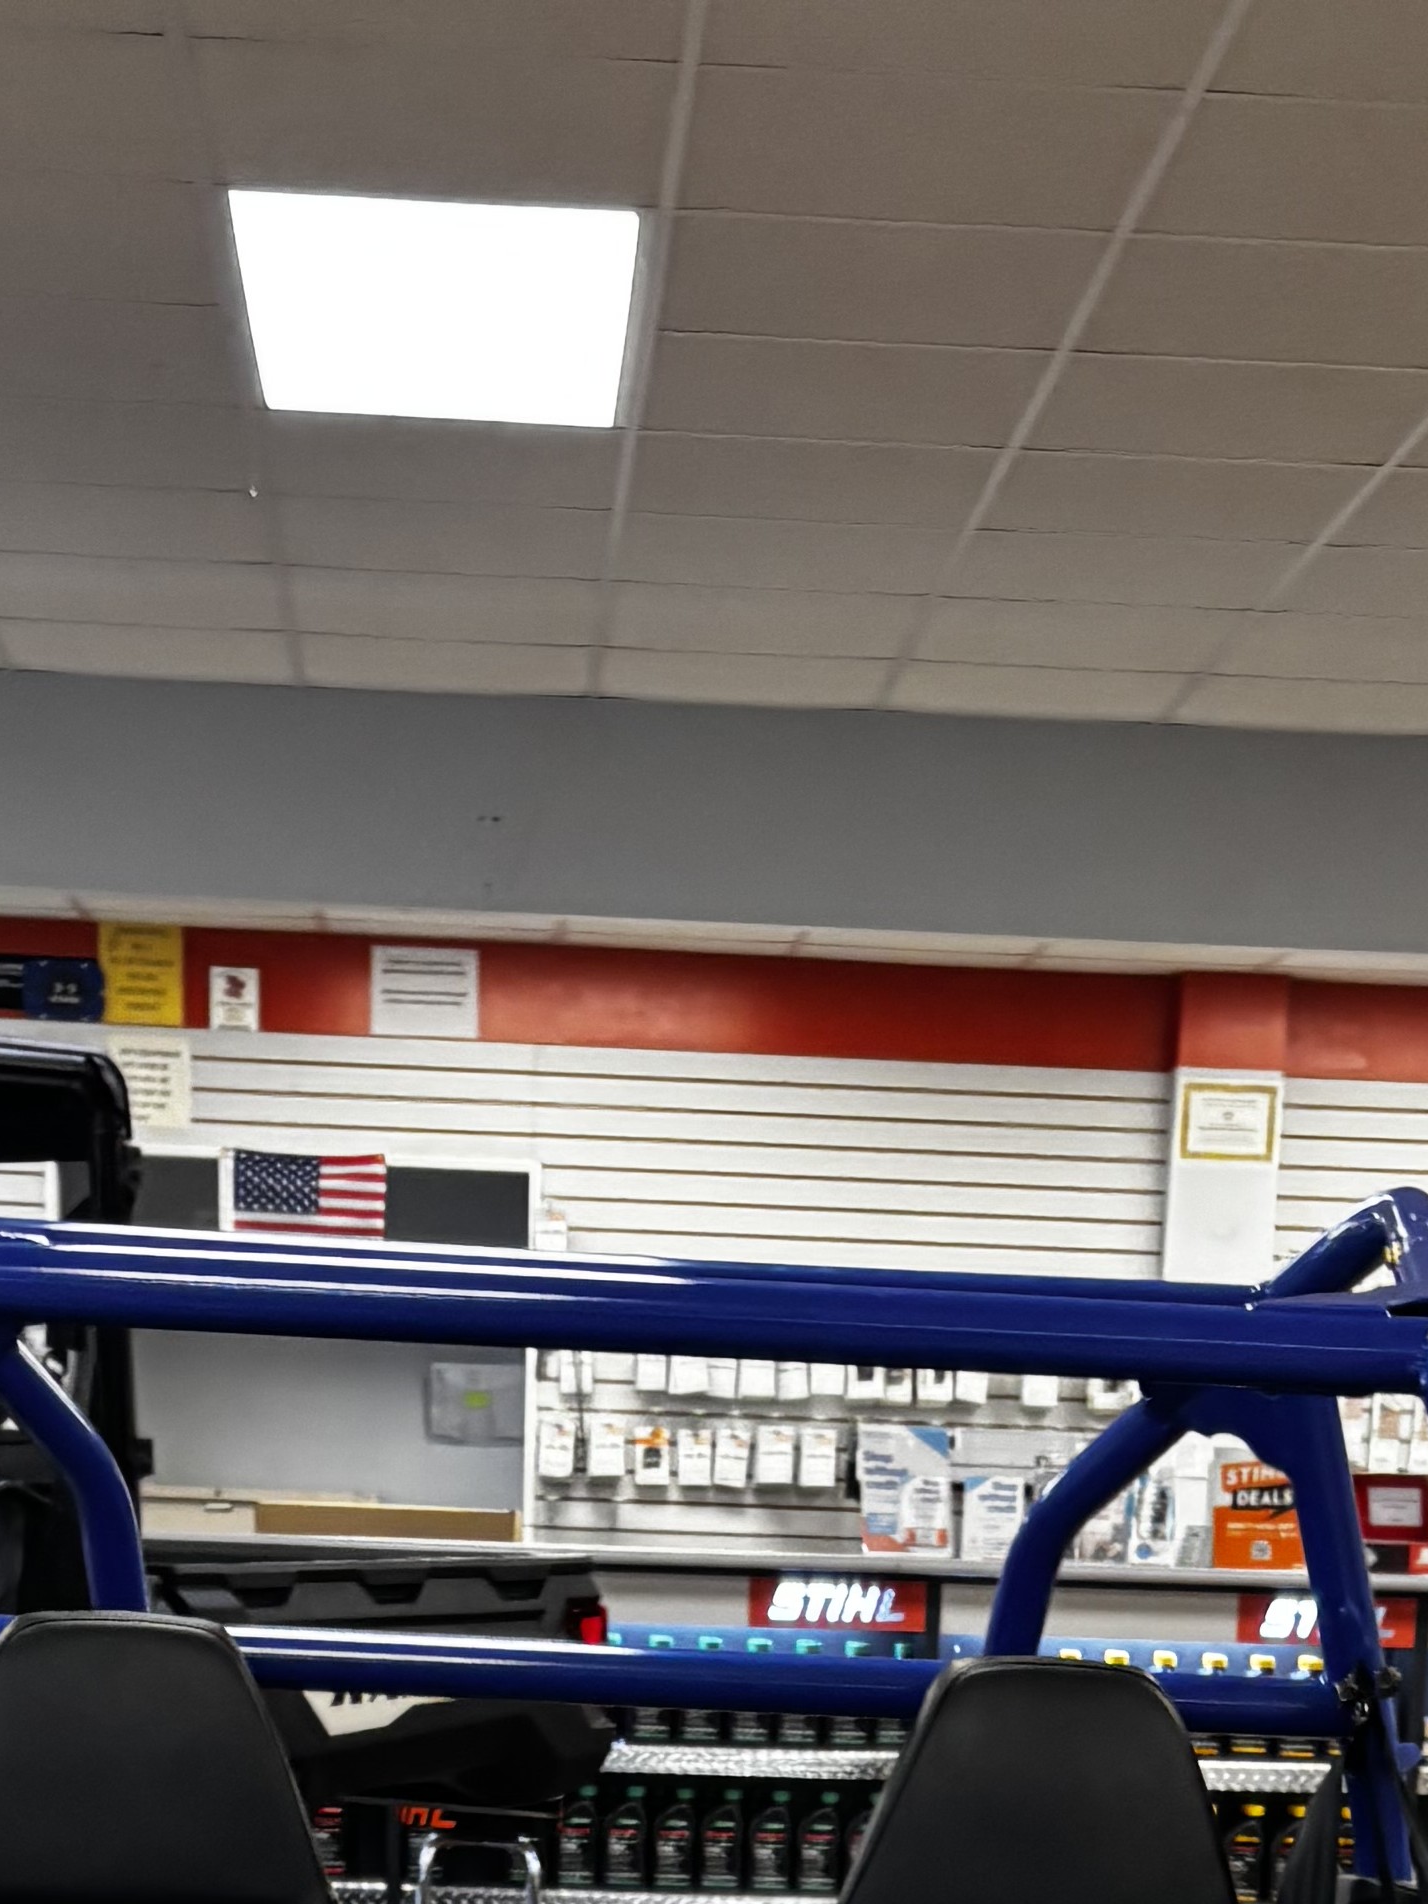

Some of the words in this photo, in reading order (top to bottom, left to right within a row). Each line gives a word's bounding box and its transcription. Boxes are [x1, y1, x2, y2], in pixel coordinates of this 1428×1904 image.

[1236, 1488, 1293, 1507] DEALS
[767, 1580, 905, 1624] STIHL
[1259, 1598, 1396, 1640] STL
